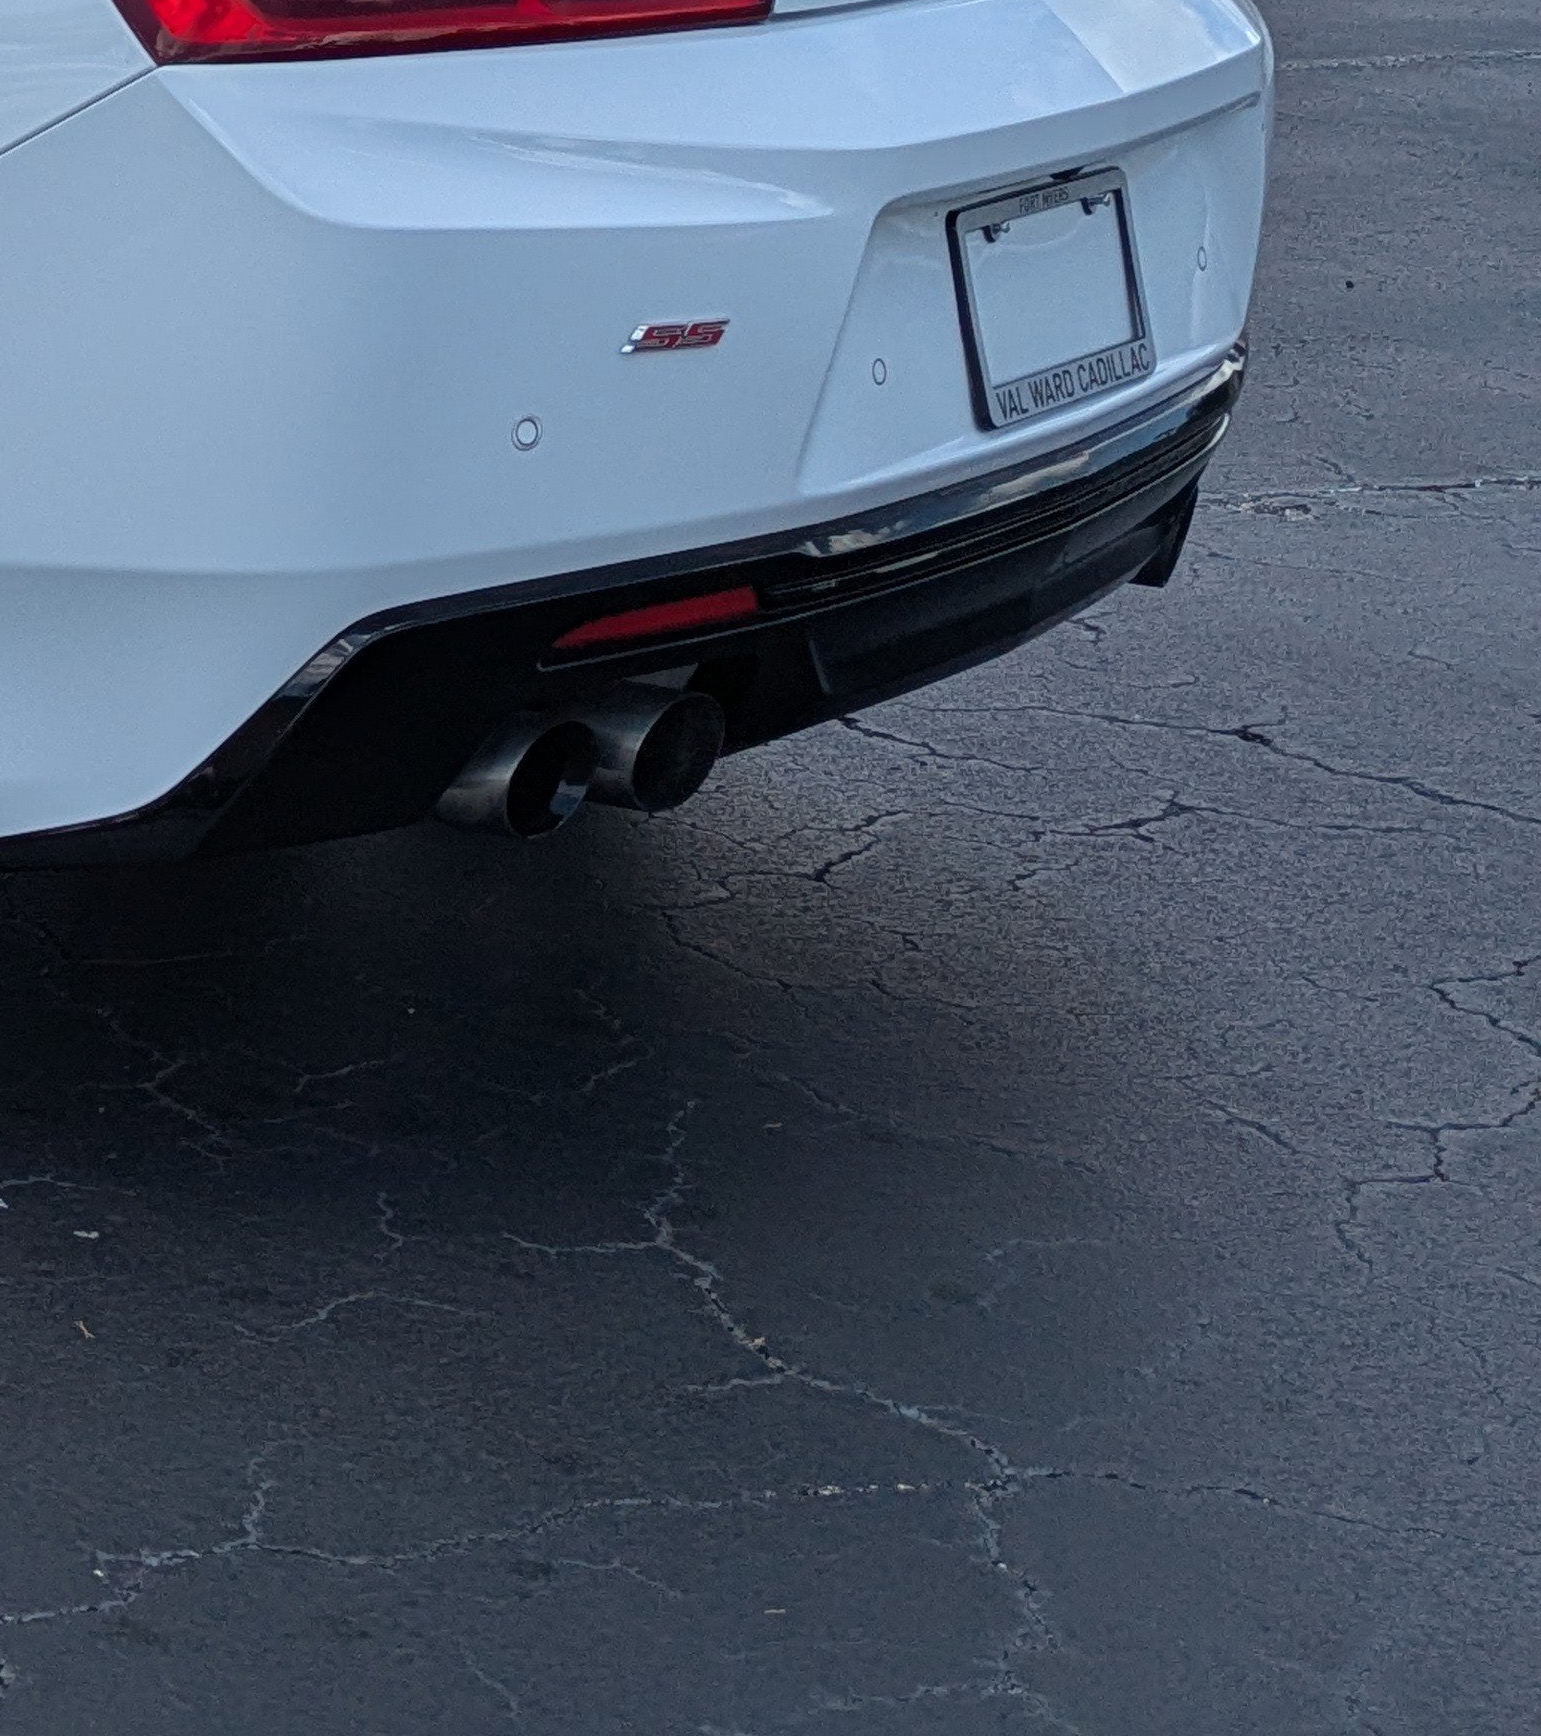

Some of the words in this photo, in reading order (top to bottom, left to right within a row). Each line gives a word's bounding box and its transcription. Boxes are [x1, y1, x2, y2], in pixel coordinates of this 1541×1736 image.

[620, 318, 729, 353] SS
[996, 385, 1029, 420] VAL
[1028, 368, 1075, 408] WARD
[1077, 342, 1150, 393] CADILLAC
